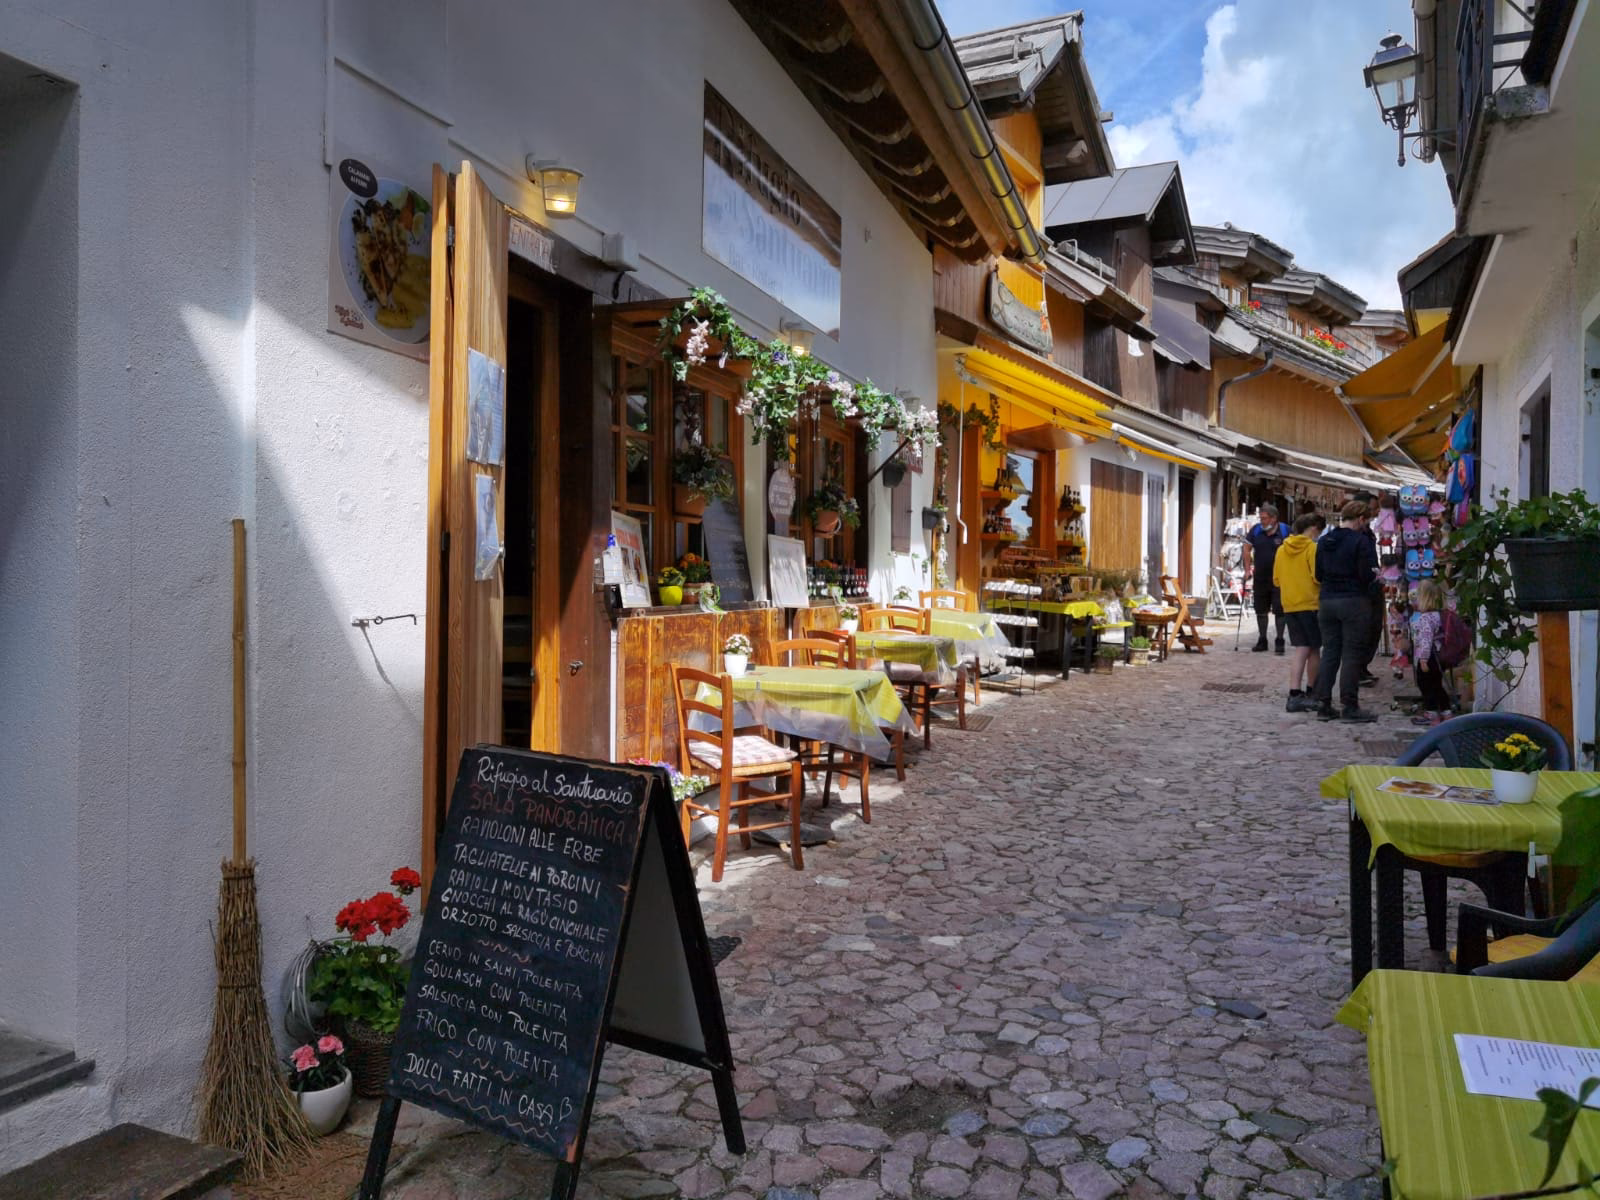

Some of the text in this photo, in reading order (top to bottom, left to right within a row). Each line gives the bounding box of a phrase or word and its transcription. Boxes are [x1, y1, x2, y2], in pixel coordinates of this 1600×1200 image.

[477, 756, 633, 805] Rifugio al Santuario
[460, 815, 604, 863] RAVIOLONI ALLE ERBE
[470, 791, 625, 845] SALA PANORAMICA
[448, 868, 578, 914] RAVIOLI MONTASIO
[454, 843, 601, 899] TAGLIATELLE AI PORCINI
[441, 887, 497, 913] GNOCCHI
[500, 901, 513, 915] AL
[441, 906, 498, 932] ORZOTTO
[501, 923, 550, 950] SALSICCIA
[554, 939, 562, 951] E
[423, 958, 568, 1026] GOULASCH CON POLENTA
[428, 939, 462, 961] CERVO
[468, 952, 480, 966] IN
[521, 968, 583, 1000] POLENTA
[417, 984, 568, 1056] SALSICCIA CON POLENTA
[416, 1008, 559, 1088] FRICO CON POLENTA
[403, 1052, 443, 1082] DOLCI
[452, 1069, 493, 1097] FATTI
[499, 1087, 513, 1107] IN
